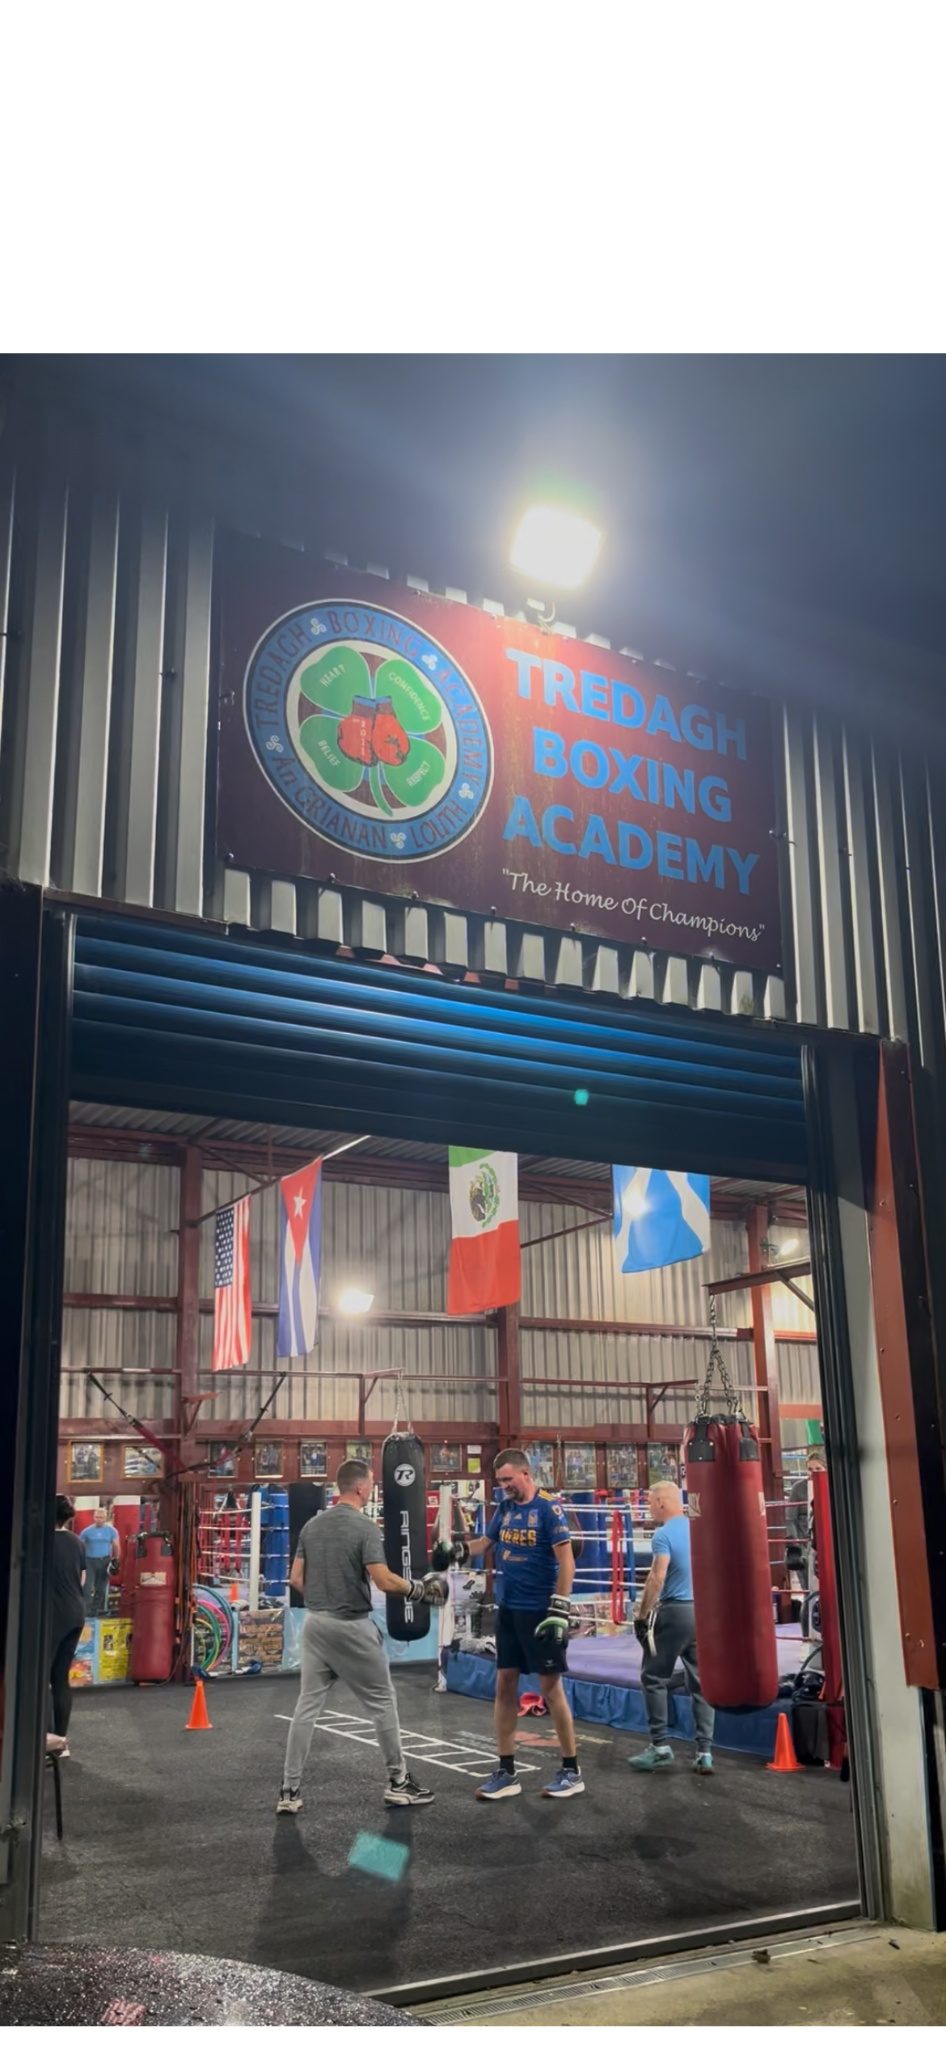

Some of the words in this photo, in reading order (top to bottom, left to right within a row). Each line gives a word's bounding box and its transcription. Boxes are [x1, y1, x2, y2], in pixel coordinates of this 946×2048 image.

[254, 621, 313, 730] TREDAGH
[326, 610, 421, 657] BOXING
[434, 667, 483, 789] ACADEMY
[319, 663, 346, 688] HEART
[388, 671, 431, 722] CONFIDENCE
[505, 647, 748, 761] TREDAGH
[317, 739, 341, 767] BELIEF
[532, 726, 732, 823] BOXING
[408, 799, 468, 849] LOUTH
[502, 795, 760, 895] ACADEMY
[502, 868, 552, 897] "The
[554, 881, 619, 911] Home
[621, 897, 648, 920] Of
[649, 902, 766, 942] Champions"
[400, 1510, 414, 1624] RINGSE
